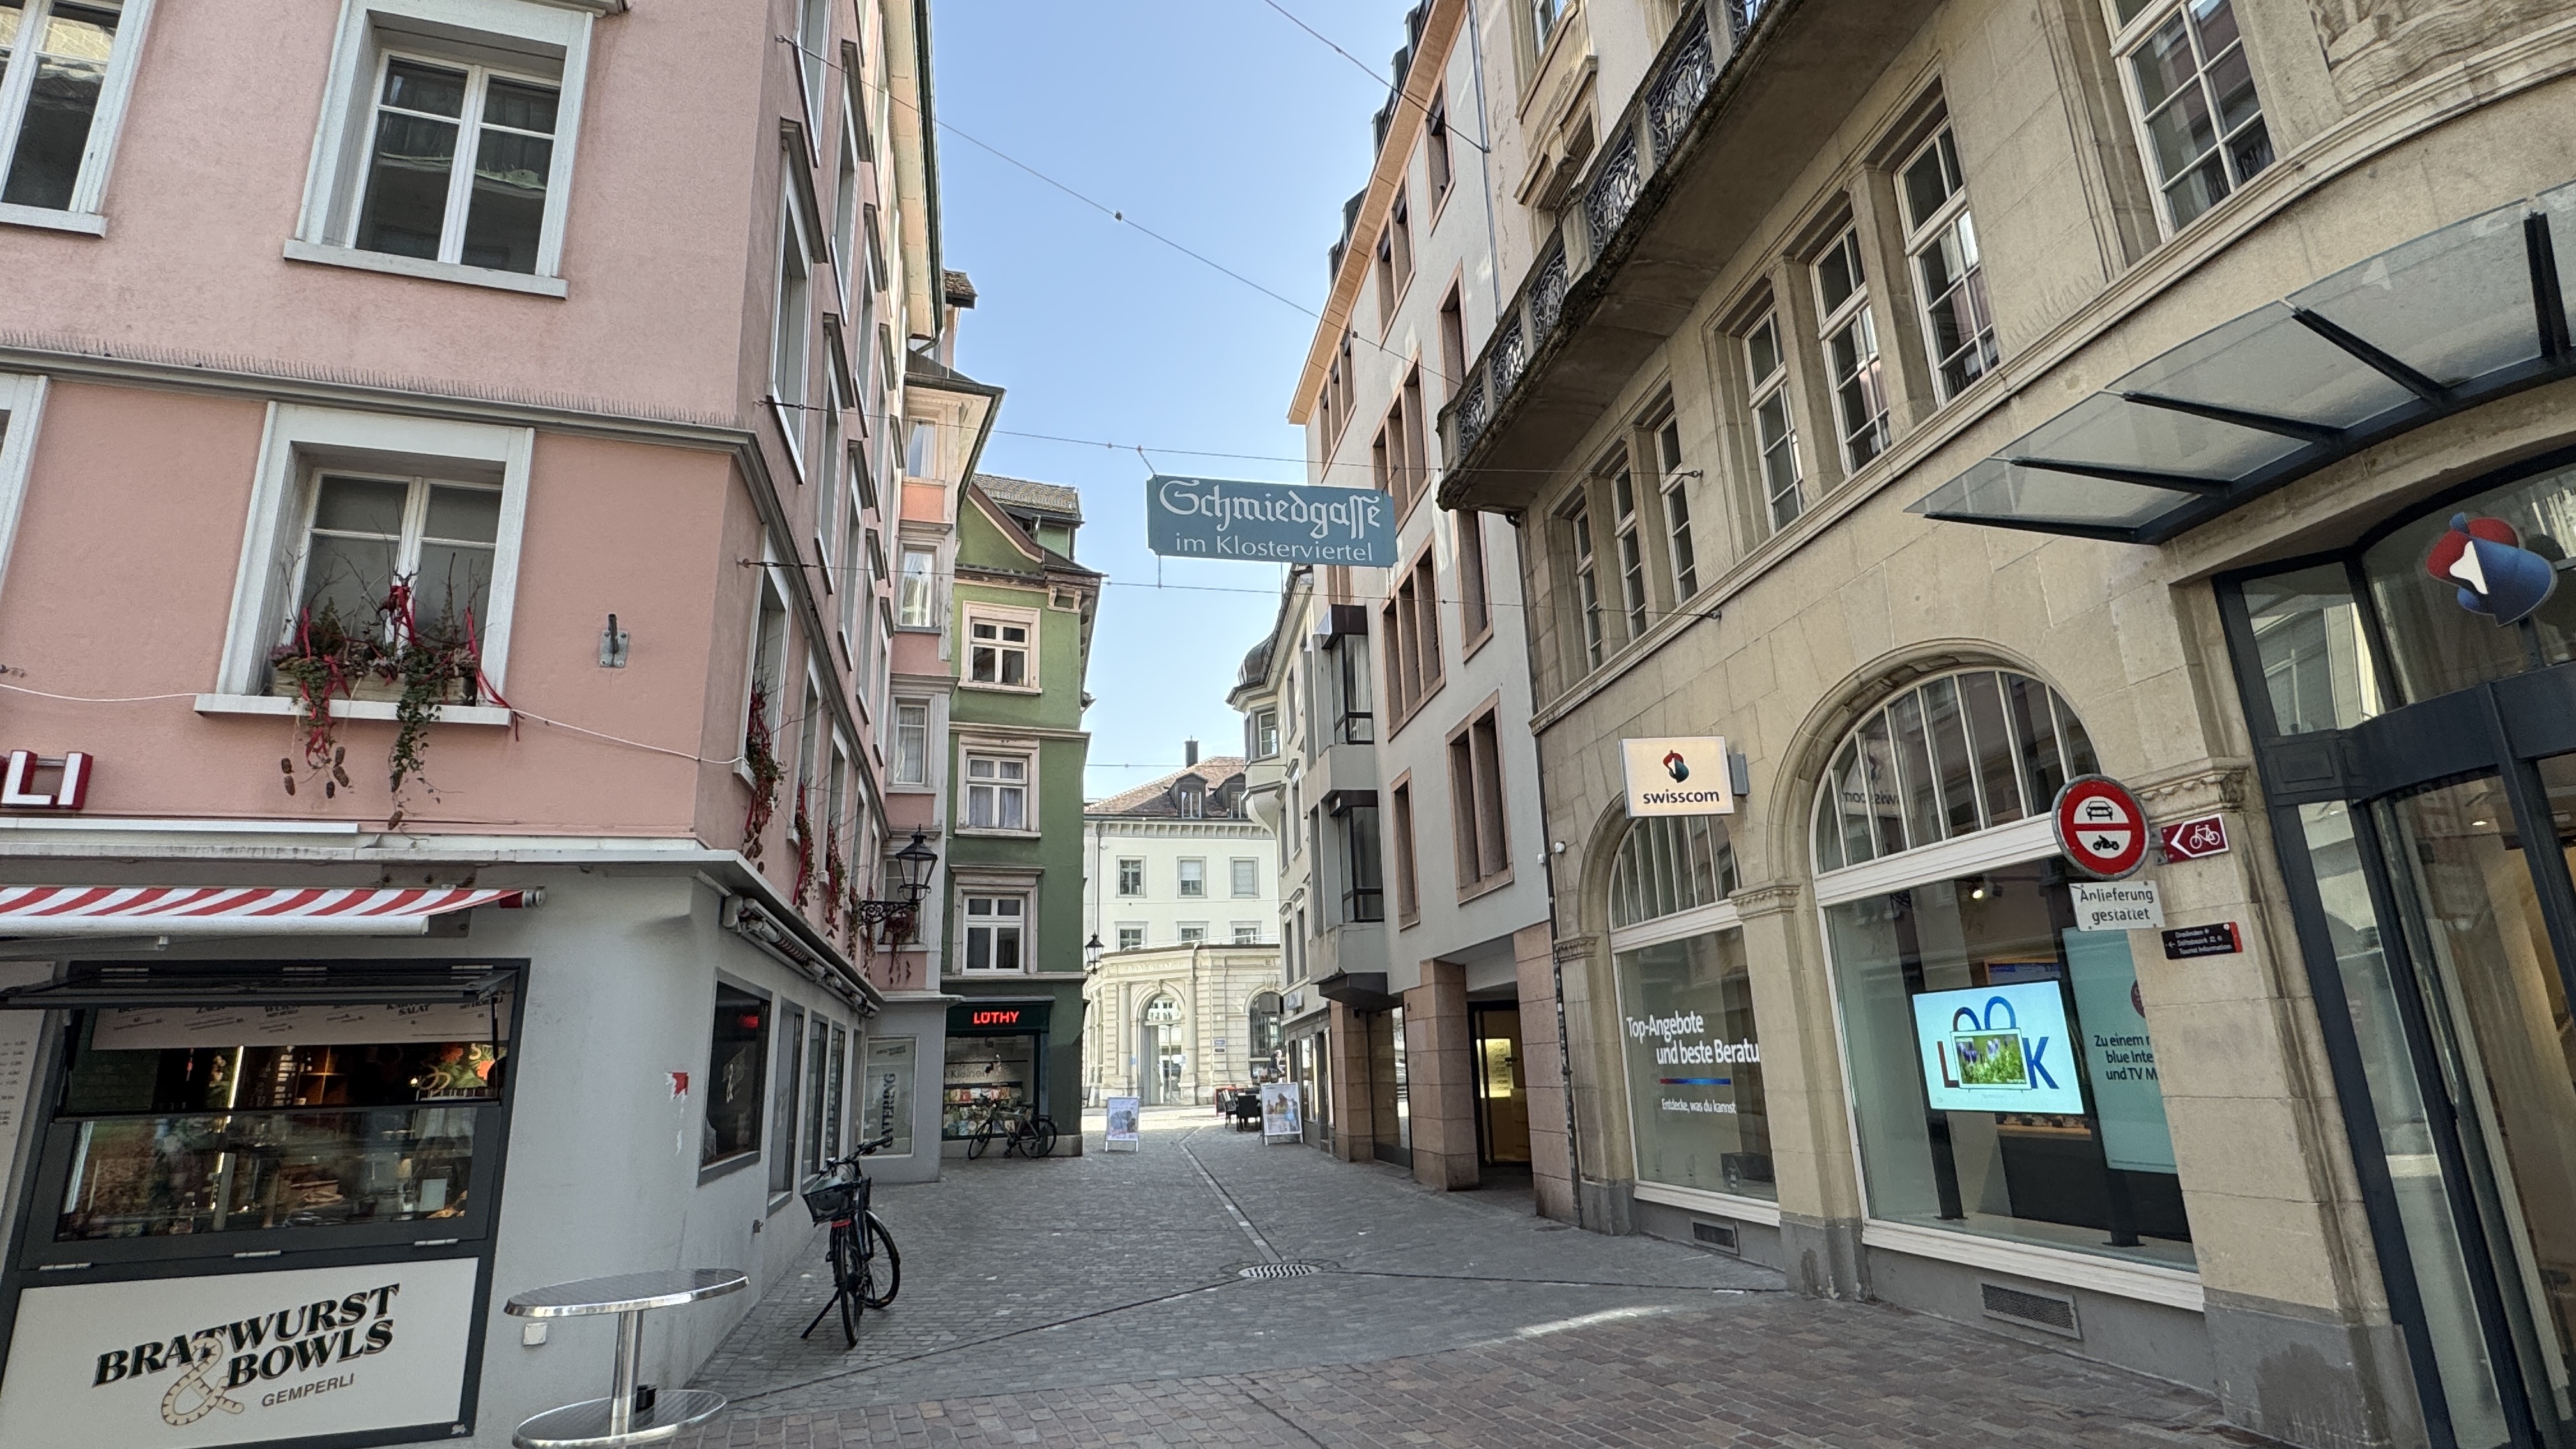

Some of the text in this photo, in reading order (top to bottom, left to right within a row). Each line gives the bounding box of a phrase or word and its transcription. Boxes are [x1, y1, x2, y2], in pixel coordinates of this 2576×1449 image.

[1159, 480, 1381, 539] Schmiedgasse
[1176, 533, 1372, 562] im Klosterviertel
[1643, 788, 1720, 804] swisscom
[2080, 887, 2154, 903] Anlieferung
[2092, 908, 2150, 925] gestattet
[973, 1011, 1020, 1024] LÜTHY
[1626, 1010, 1705, 1044] Top-Angebote
[2094, 1035, 2108, 1046] Zu
[2110, 1032, 2143, 1046] einem
[1656, 1038, 1760, 1064] und beste Beratu
[2105, 1050, 2154, 1063] blue Inte
[2106, 1066, 2127, 1080] und
[2128, 1067, 2142, 1080] TV
[881, 1073, 896, 1148] CATERING
[1661, 1098, 1737, 1114] Entdecke, was du kannst
[92, 1283, 400, 1388] BRATWURST
[221, 1319, 394, 1391] BOWLS
[261, 1373, 355, 1407] GEMPERLI
